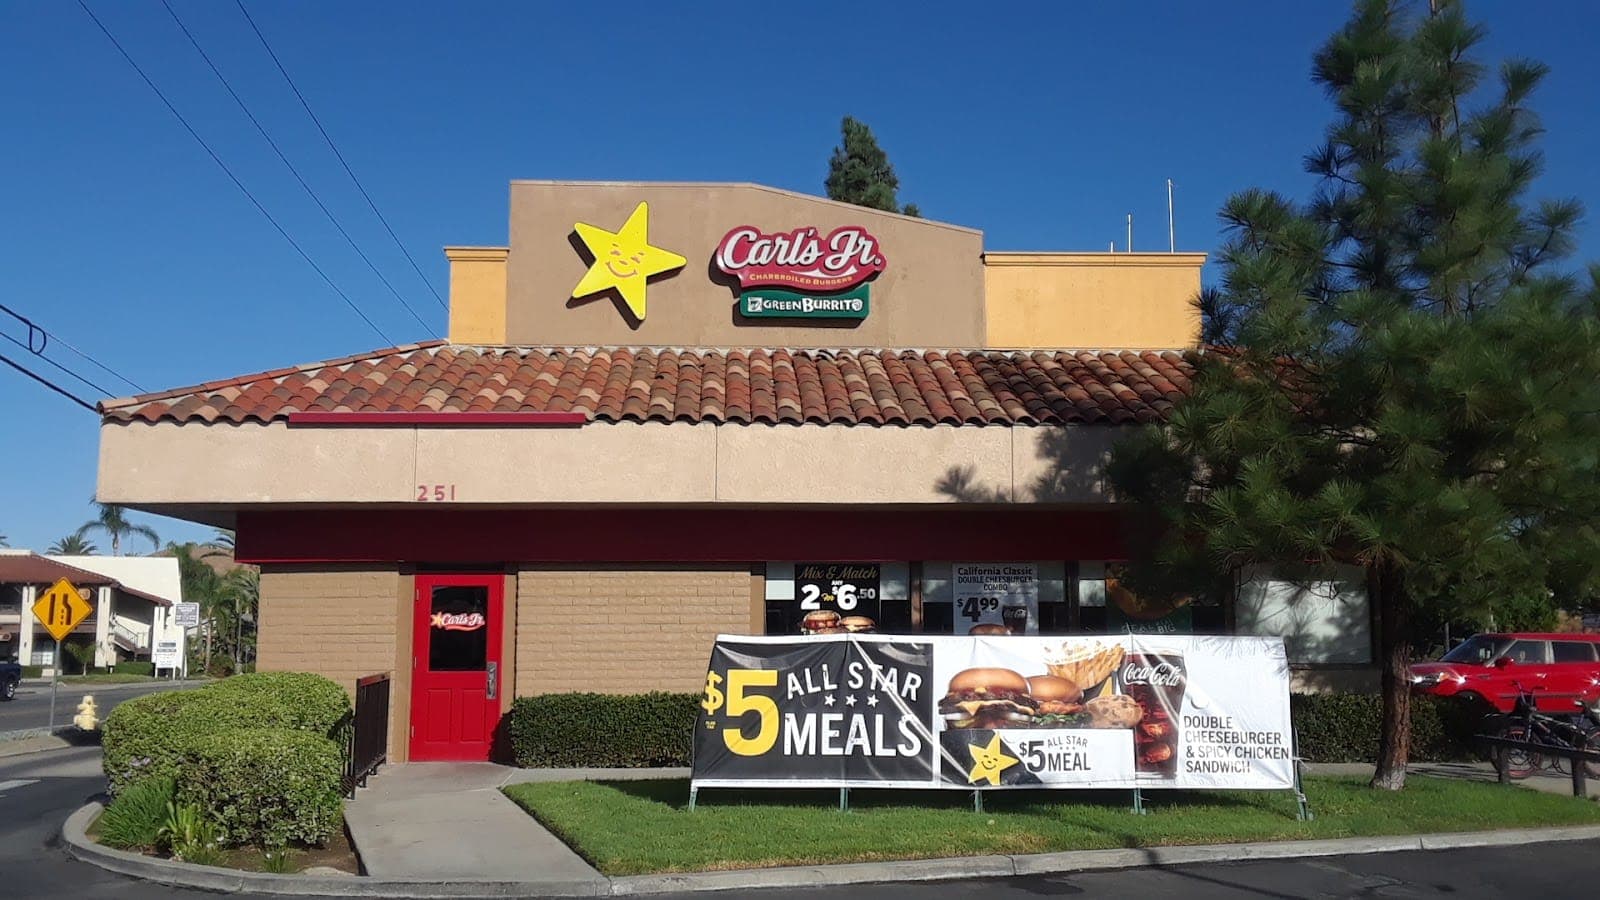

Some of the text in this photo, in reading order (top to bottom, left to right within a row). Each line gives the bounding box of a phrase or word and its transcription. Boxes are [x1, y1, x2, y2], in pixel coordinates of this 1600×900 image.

[723, 229, 881, 271] Carl's Jr.
[417, 485, 455, 501] 251
[797, 565, 878, 580] Mix & Match
[958, 567, 1033, 575] California Classic
[800, 584, 821, 610] 2
[442, 613, 468, 626] Carl's
[787, 661, 922, 701] ALL STAR
[701, 669, 780, 757] $5
[1183, 715, 1233, 729] DOUBLE
[784, 712, 923, 758] MEALS
[1047, 735, 1088, 748] ALL STAR
[1185, 730, 1282, 744] CHEESEBURGER
[1019, 740, 1046, 772] $5
[1186, 745, 1289, 760] & SPICY CHICKEN
[1048, 752, 1092, 772] MEAL
